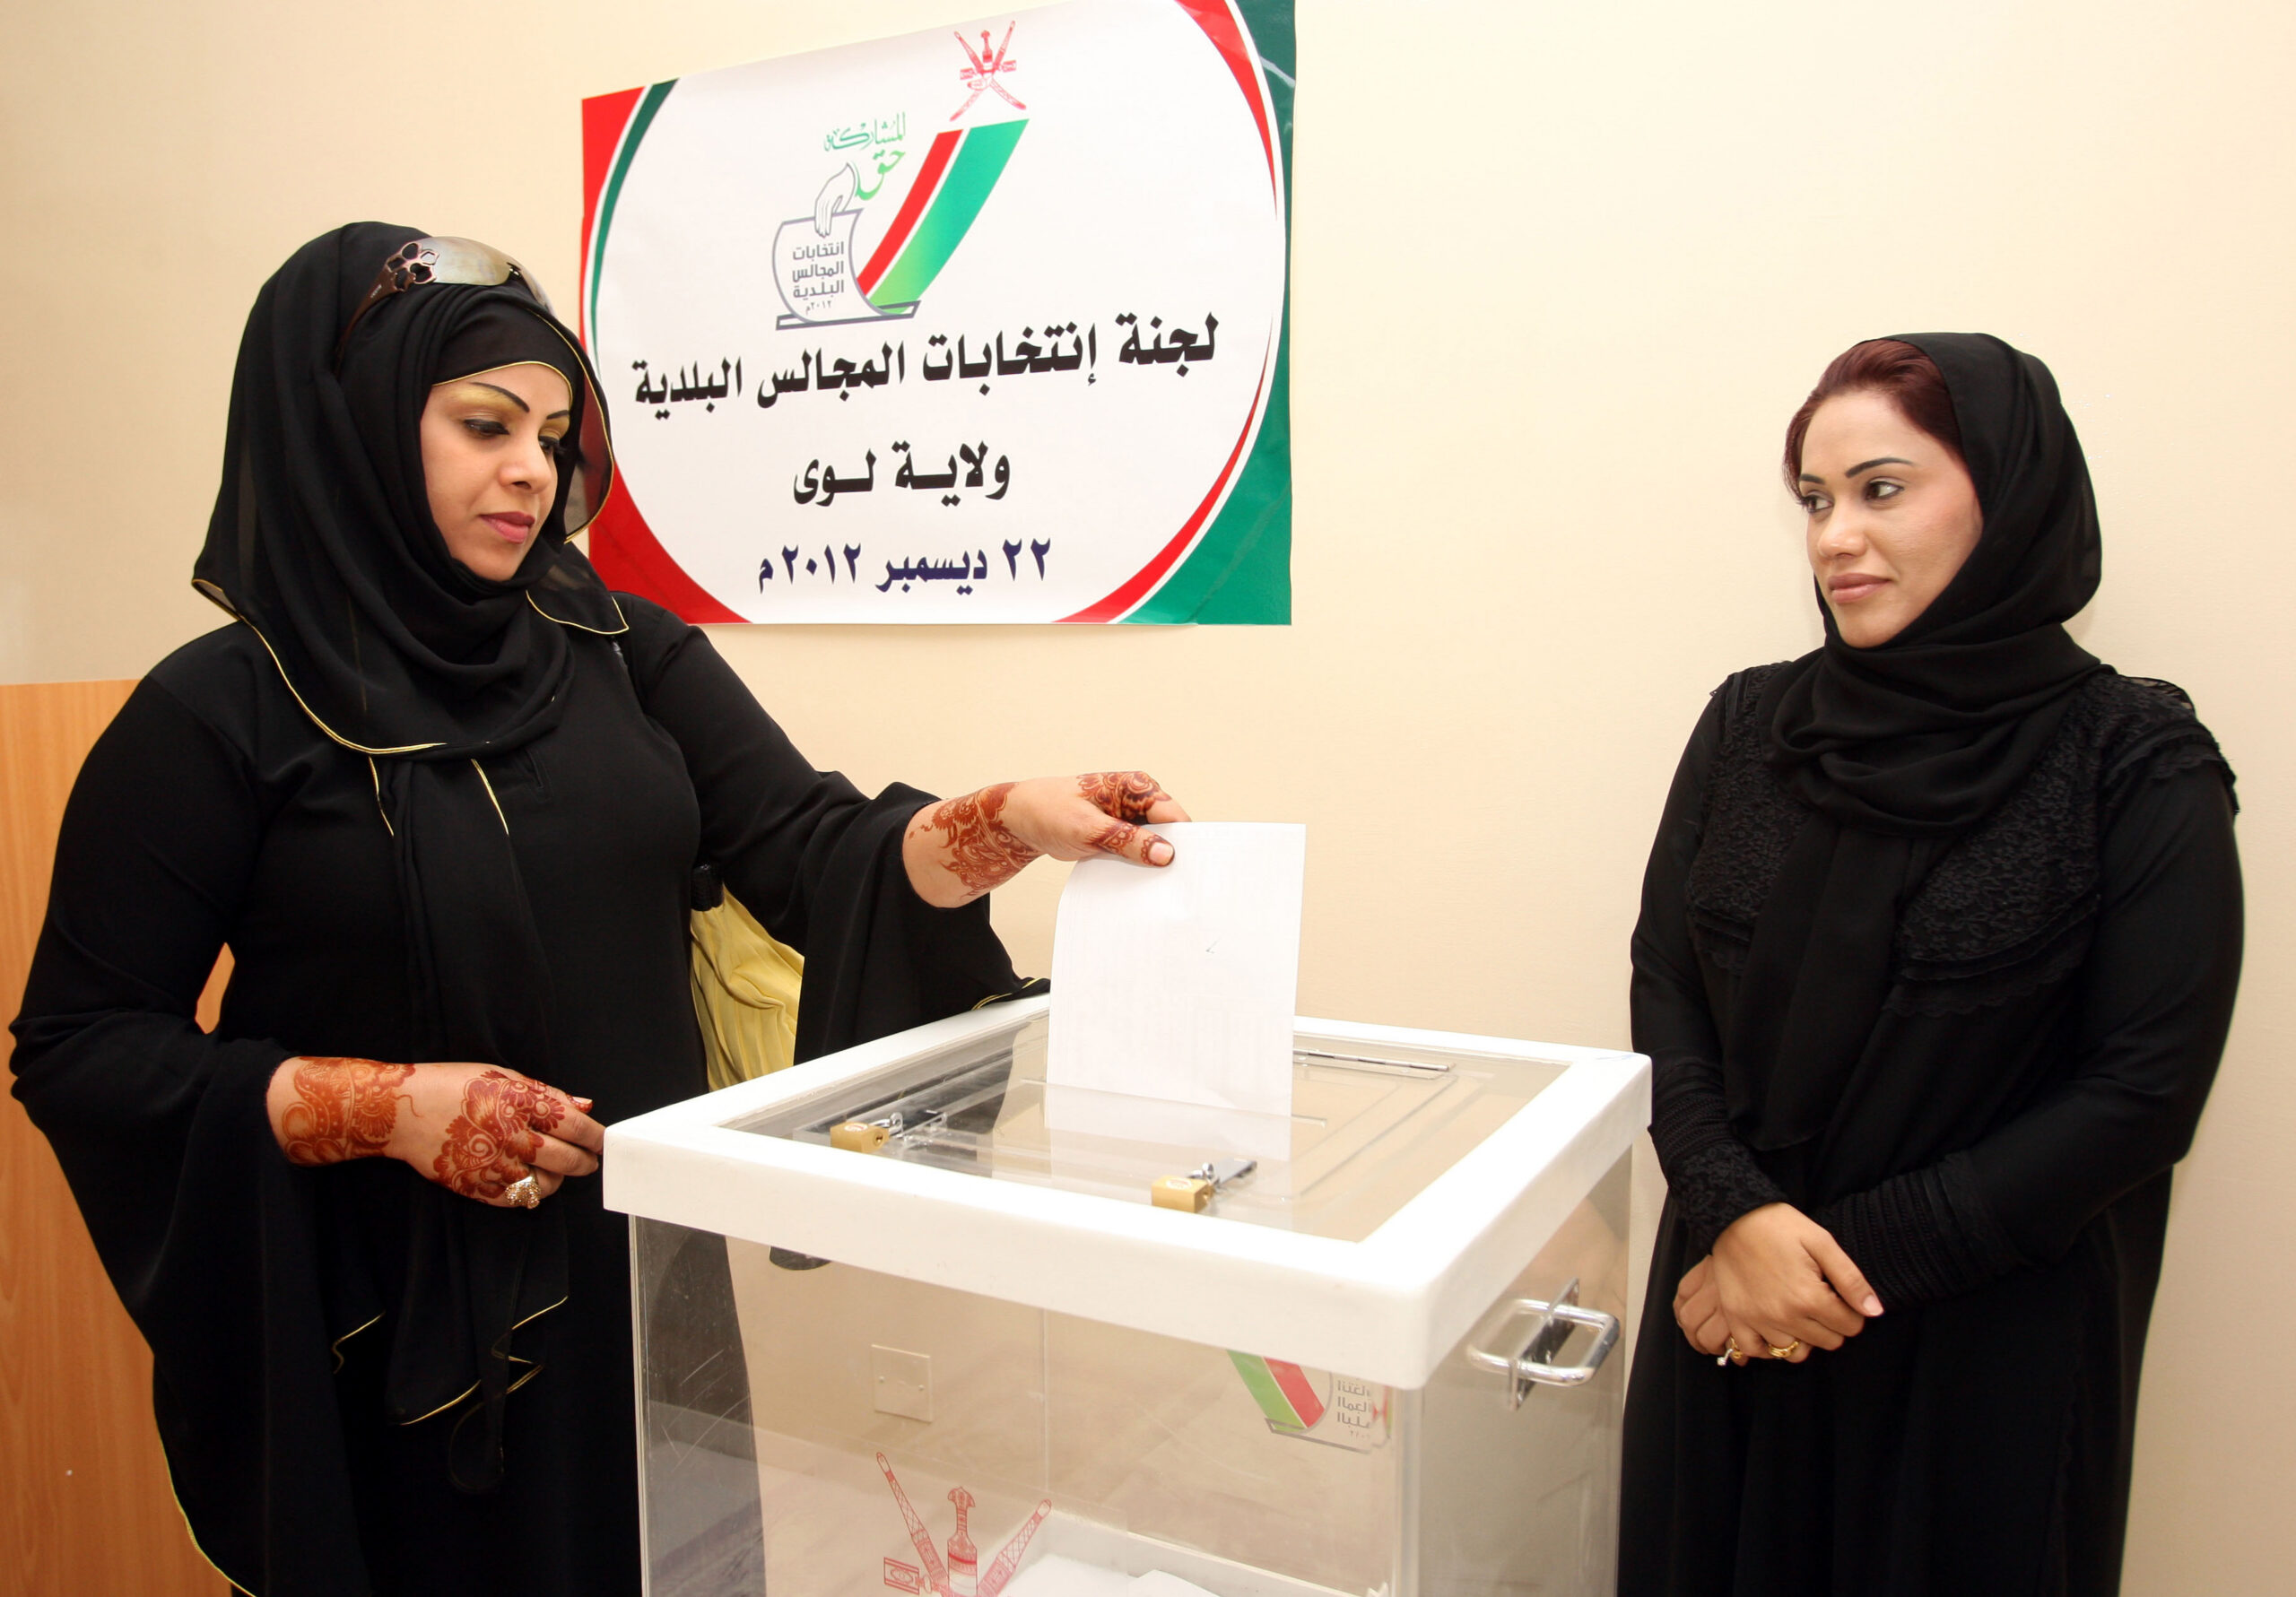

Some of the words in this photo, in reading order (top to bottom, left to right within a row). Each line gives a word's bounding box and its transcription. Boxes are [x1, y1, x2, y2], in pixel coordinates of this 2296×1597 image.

[853, 149, 906, 201] حق
[792, 241, 844, 260] انتخابات
[792, 261, 844, 282] المجالس
[793, 279, 844, 300] البلدية
[922, 322, 1097, 396] إنتخابات
[1116, 312, 1219, 378] لجنة
[632, 359, 743, 421] البلدية
[757, 342, 905, 409] المجالس
[875, 550, 987, 595] ديسمبر
[1004, 538, 1051, 580] ٢٢
